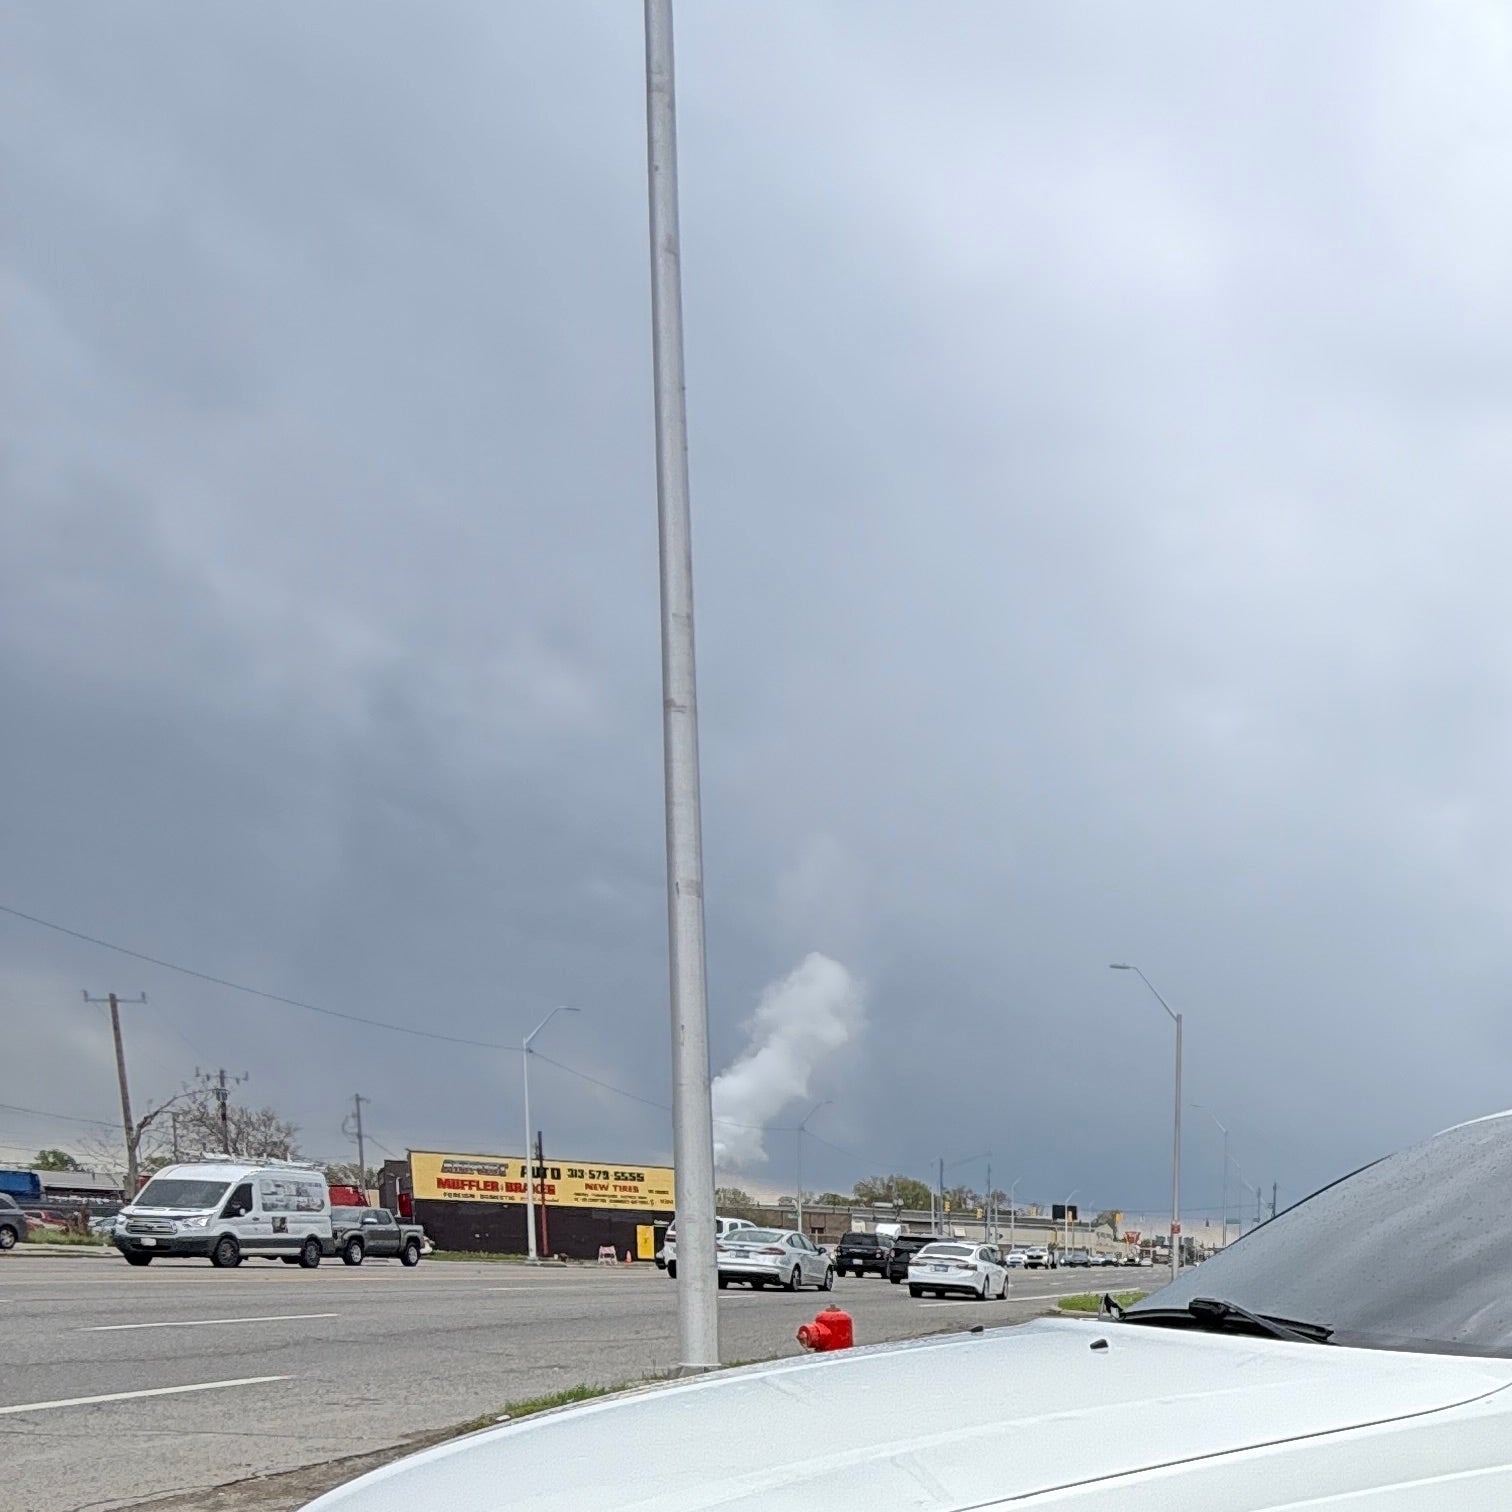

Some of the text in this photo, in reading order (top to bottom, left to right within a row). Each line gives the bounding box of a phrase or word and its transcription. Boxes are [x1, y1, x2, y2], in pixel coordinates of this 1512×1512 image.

[436, 1177, 500, 1192] MUFFLER
[584, 1182, 610, 1192] NEW
[612, 1184, 639, 1194] TIRES
